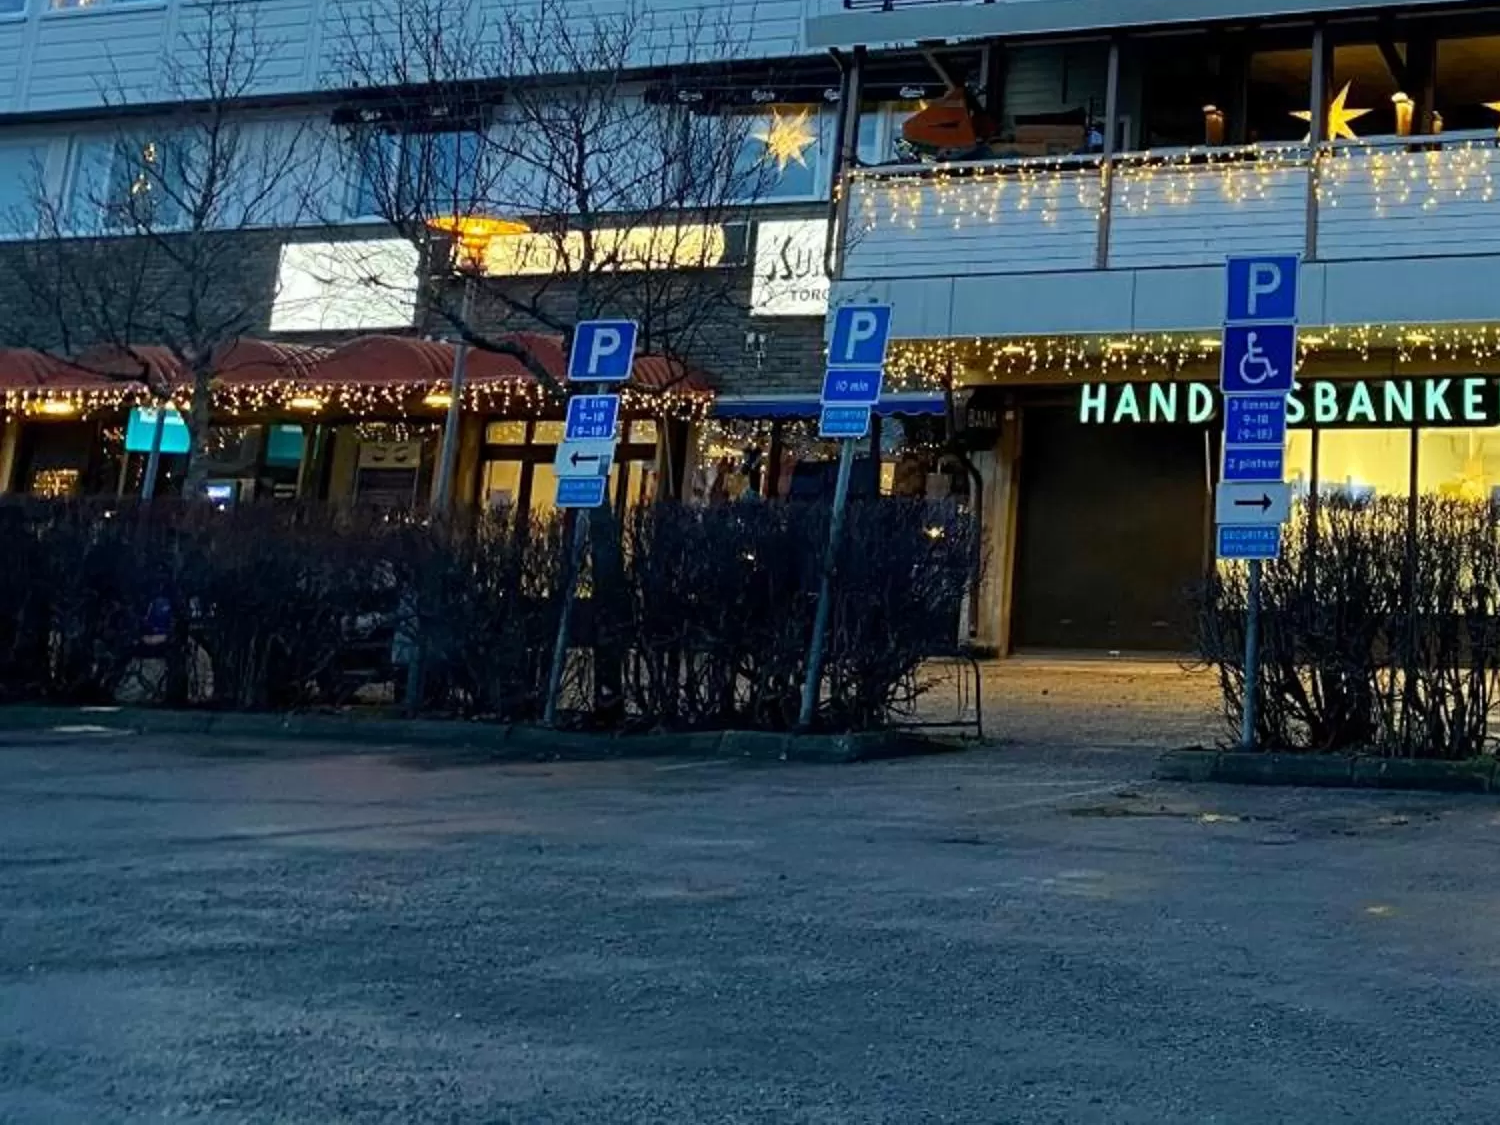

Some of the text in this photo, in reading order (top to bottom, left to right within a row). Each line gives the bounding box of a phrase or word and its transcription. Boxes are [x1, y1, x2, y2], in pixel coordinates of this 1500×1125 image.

[1247, 262, 1281, 315] P
[587, 328, 621, 374] P
[845, 311, 877, 360] P
[850, 379, 869, 392] min
